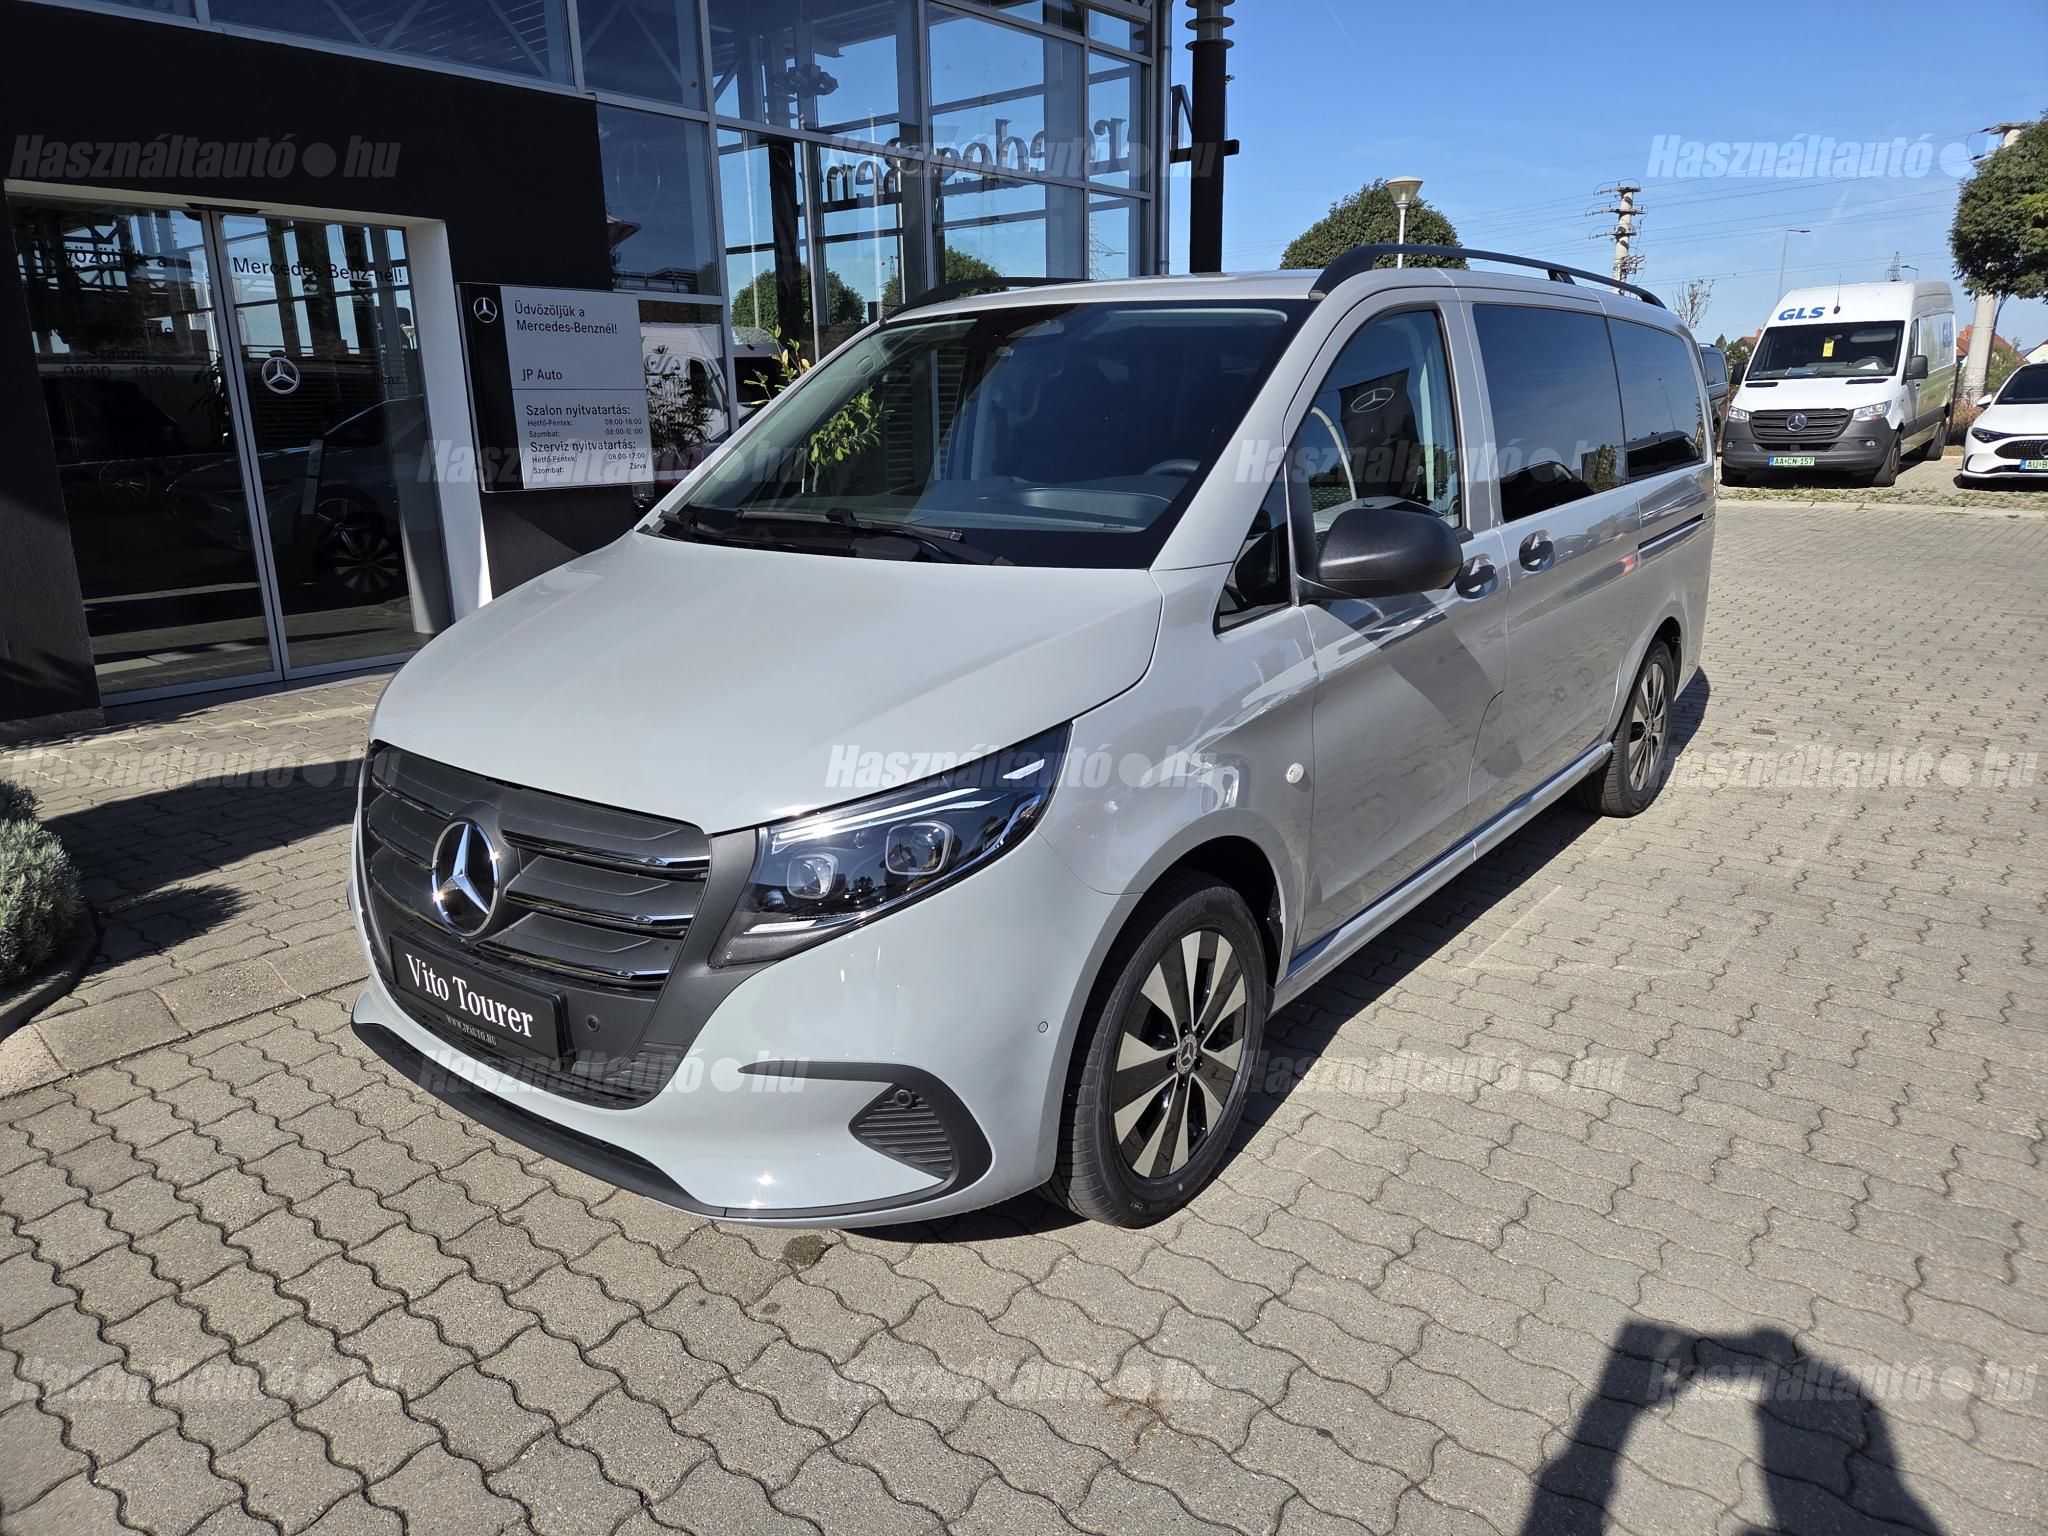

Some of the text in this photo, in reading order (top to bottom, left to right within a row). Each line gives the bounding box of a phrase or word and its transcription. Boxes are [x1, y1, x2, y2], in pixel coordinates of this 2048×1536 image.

[233, 257, 403, 283] MercedesBenz-nél!
[514, 300, 585, 318] Üdvözöljük a
[1778, 306, 1826, 321] GLS
[516, 319, 618, 335] Mercedes-Benznél!
[522, 369, 563, 381] JP Auto
[526, 403, 631, 417] Szalon nyitvatartás:
[529, 430, 560, 438] Szombat:
[531, 438, 636, 453] Szerviz nyitvatartás:
[533, 467, 564, 475] Szombat:
[405, 953, 534, 1038] Vito Tourer
